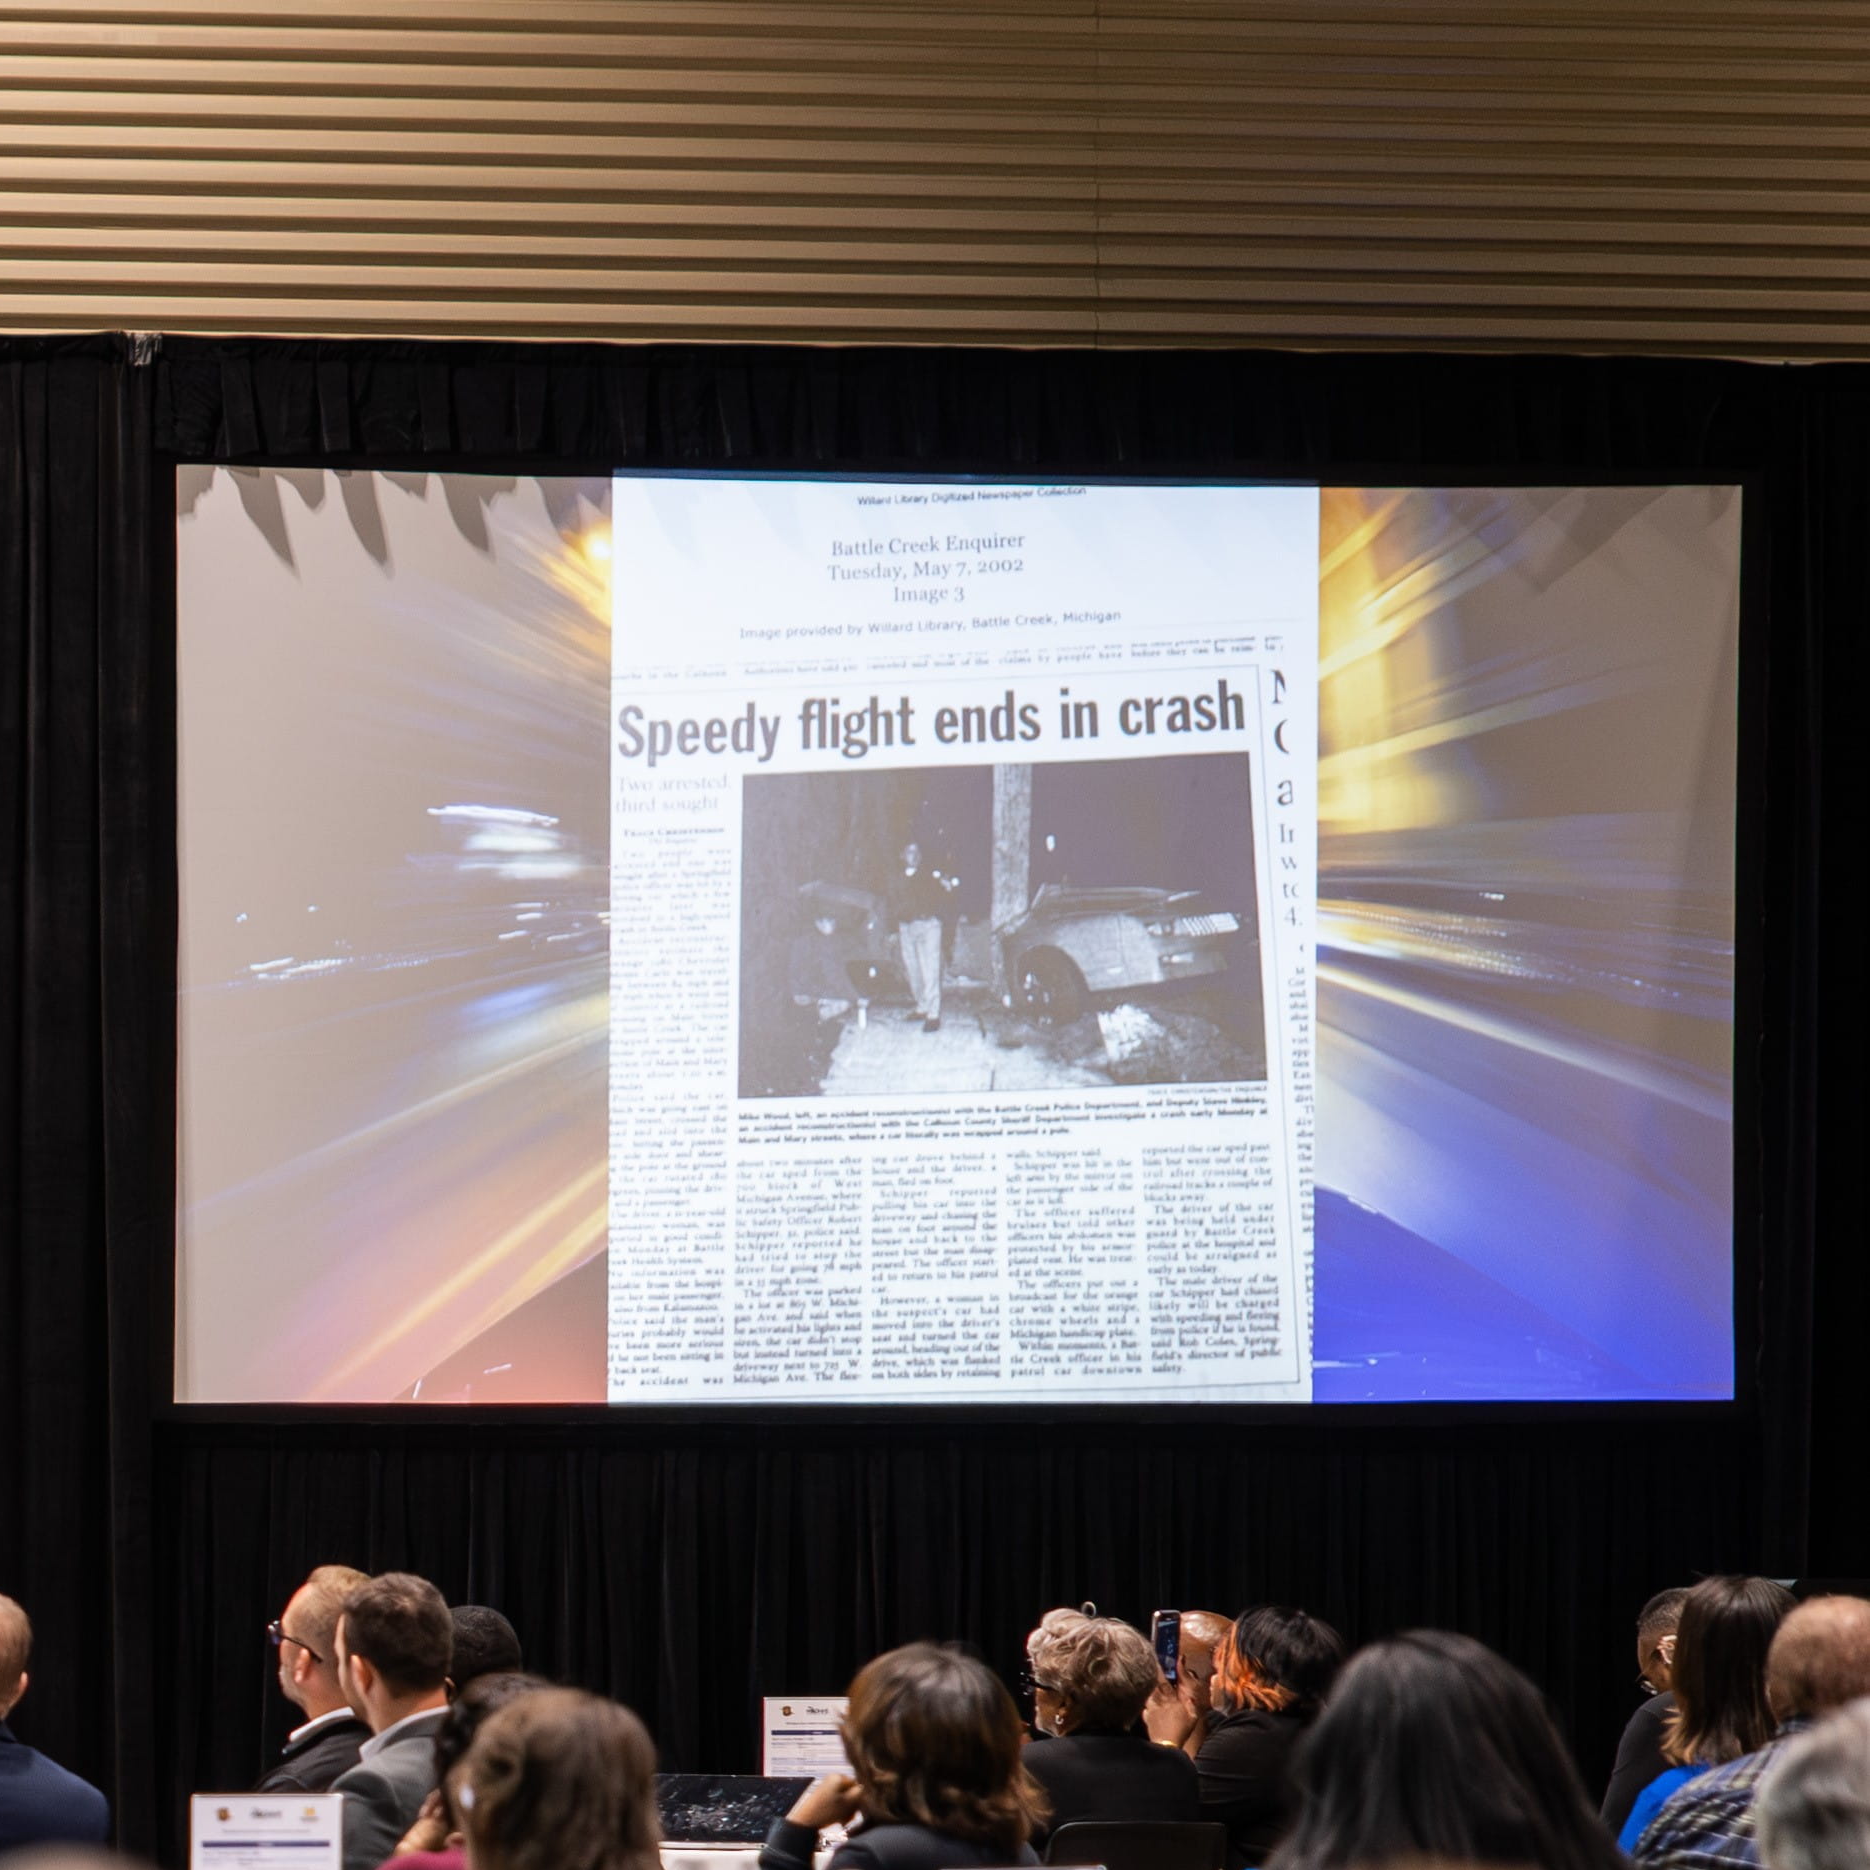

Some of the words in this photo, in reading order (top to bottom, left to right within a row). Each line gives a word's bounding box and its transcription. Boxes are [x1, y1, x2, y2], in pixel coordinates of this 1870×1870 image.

[831, 539, 885, 557] Battle
[888, 536, 940, 555] Creek
[945, 533, 1026, 555] Enquirer
[827, 563, 907, 581] Tuesday,
[913, 560, 951, 579] May
[956, 561, 971, 578] 7,
[978, 559, 1024, 573] 2002
[893, 586, 949, 604] Image
[953, 585, 966, 602] 3
[740, 625, 781, 641] Image
[785, 622, 843, 639] provided
[847, 621, 864, 636] by
[867, 619, 914, 632] Willard
[917, 617, 967, 633] Library,
[971, 615, 1011, 628] Battle
[1014, 613, 1058, 629] Creek,
[1062, 610, 1122, 627] Michigan
[618, 701, 781, 767] Speedy
[799, 695, 915, 758] flight
[934, 688, 1041, 744] ends
[1060, 686, 1100, 740] in
[1118, 679, 1246, 736] crash
